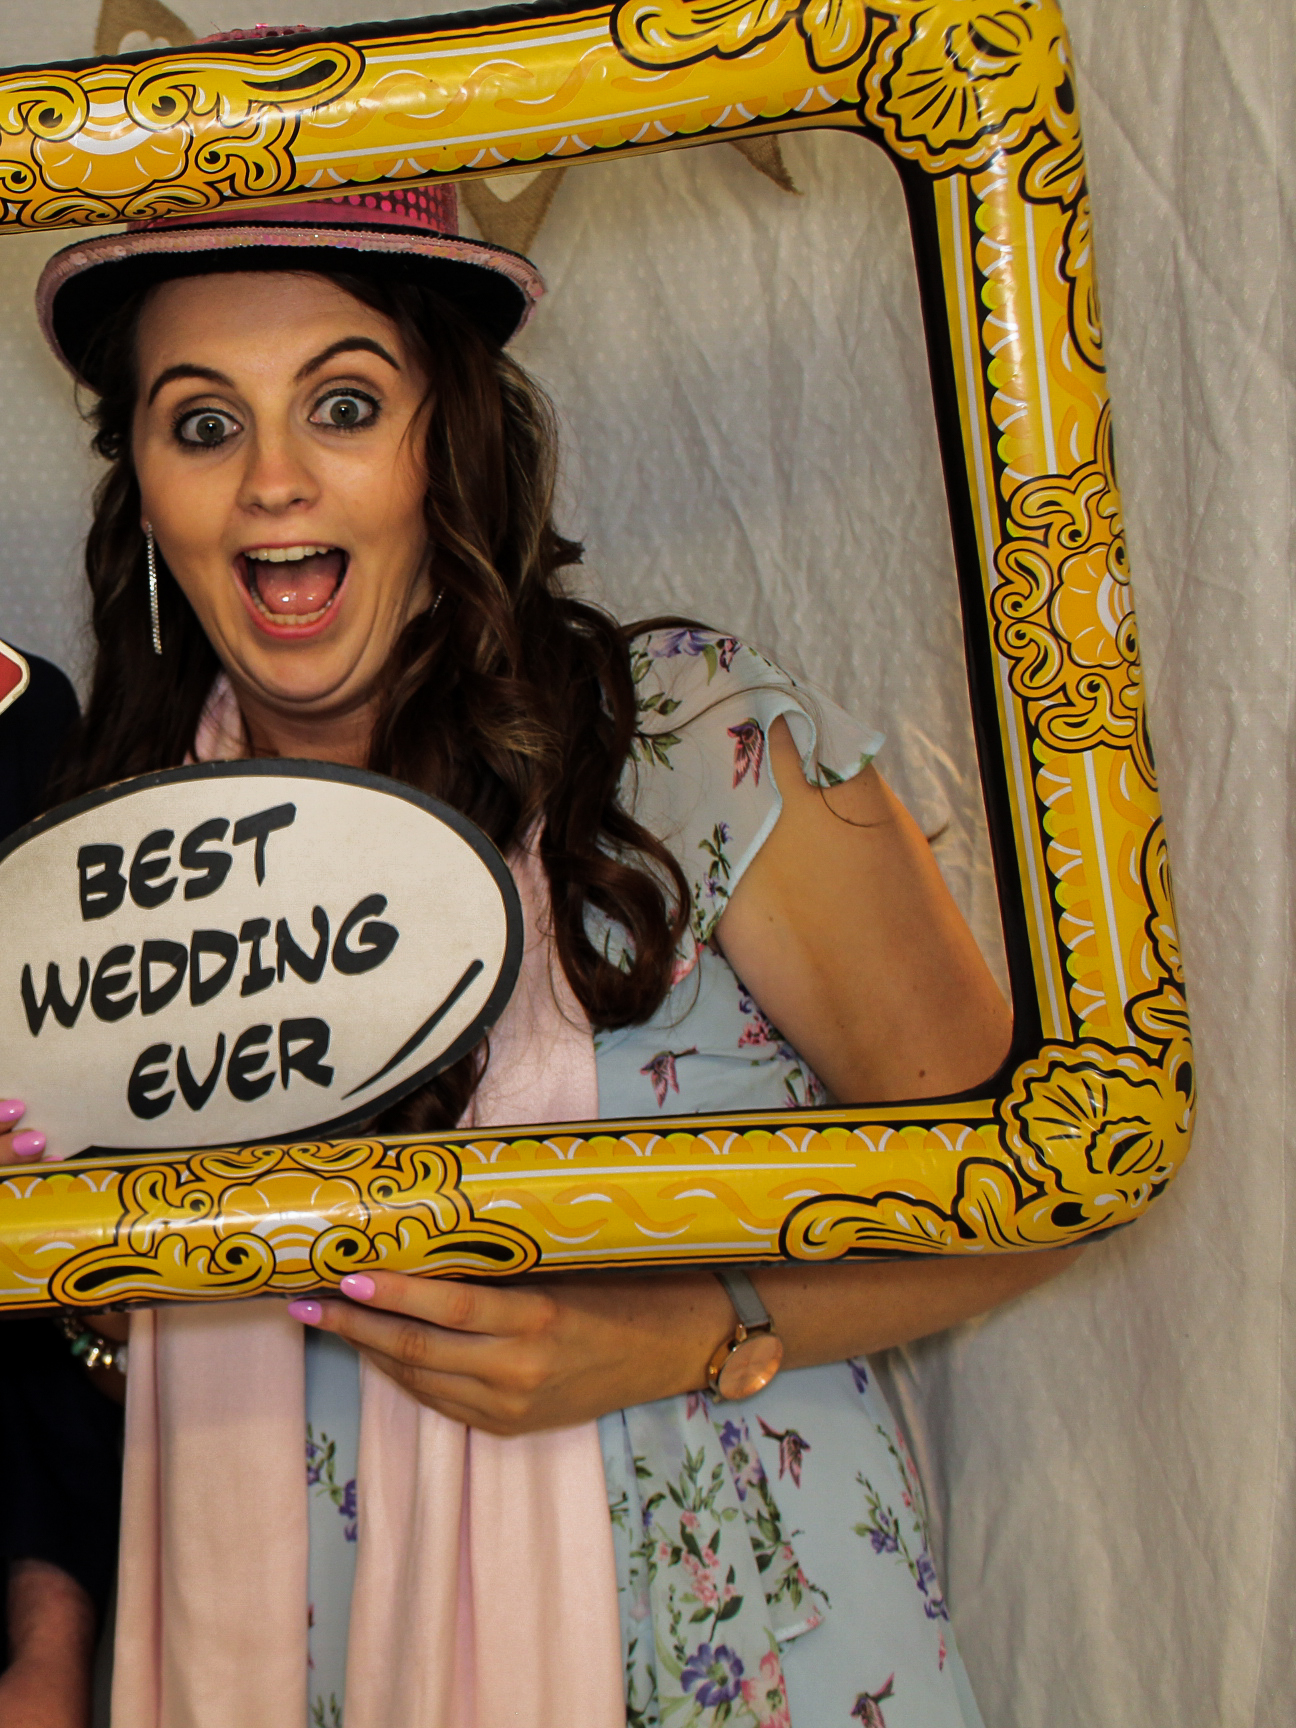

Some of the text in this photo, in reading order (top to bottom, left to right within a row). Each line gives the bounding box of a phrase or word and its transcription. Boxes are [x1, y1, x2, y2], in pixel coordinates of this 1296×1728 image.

[77, 802, 297, 922] BEST
[20, 893, 400, 1037] WEDDING
[127, 1016, 335, 1120] EVER
